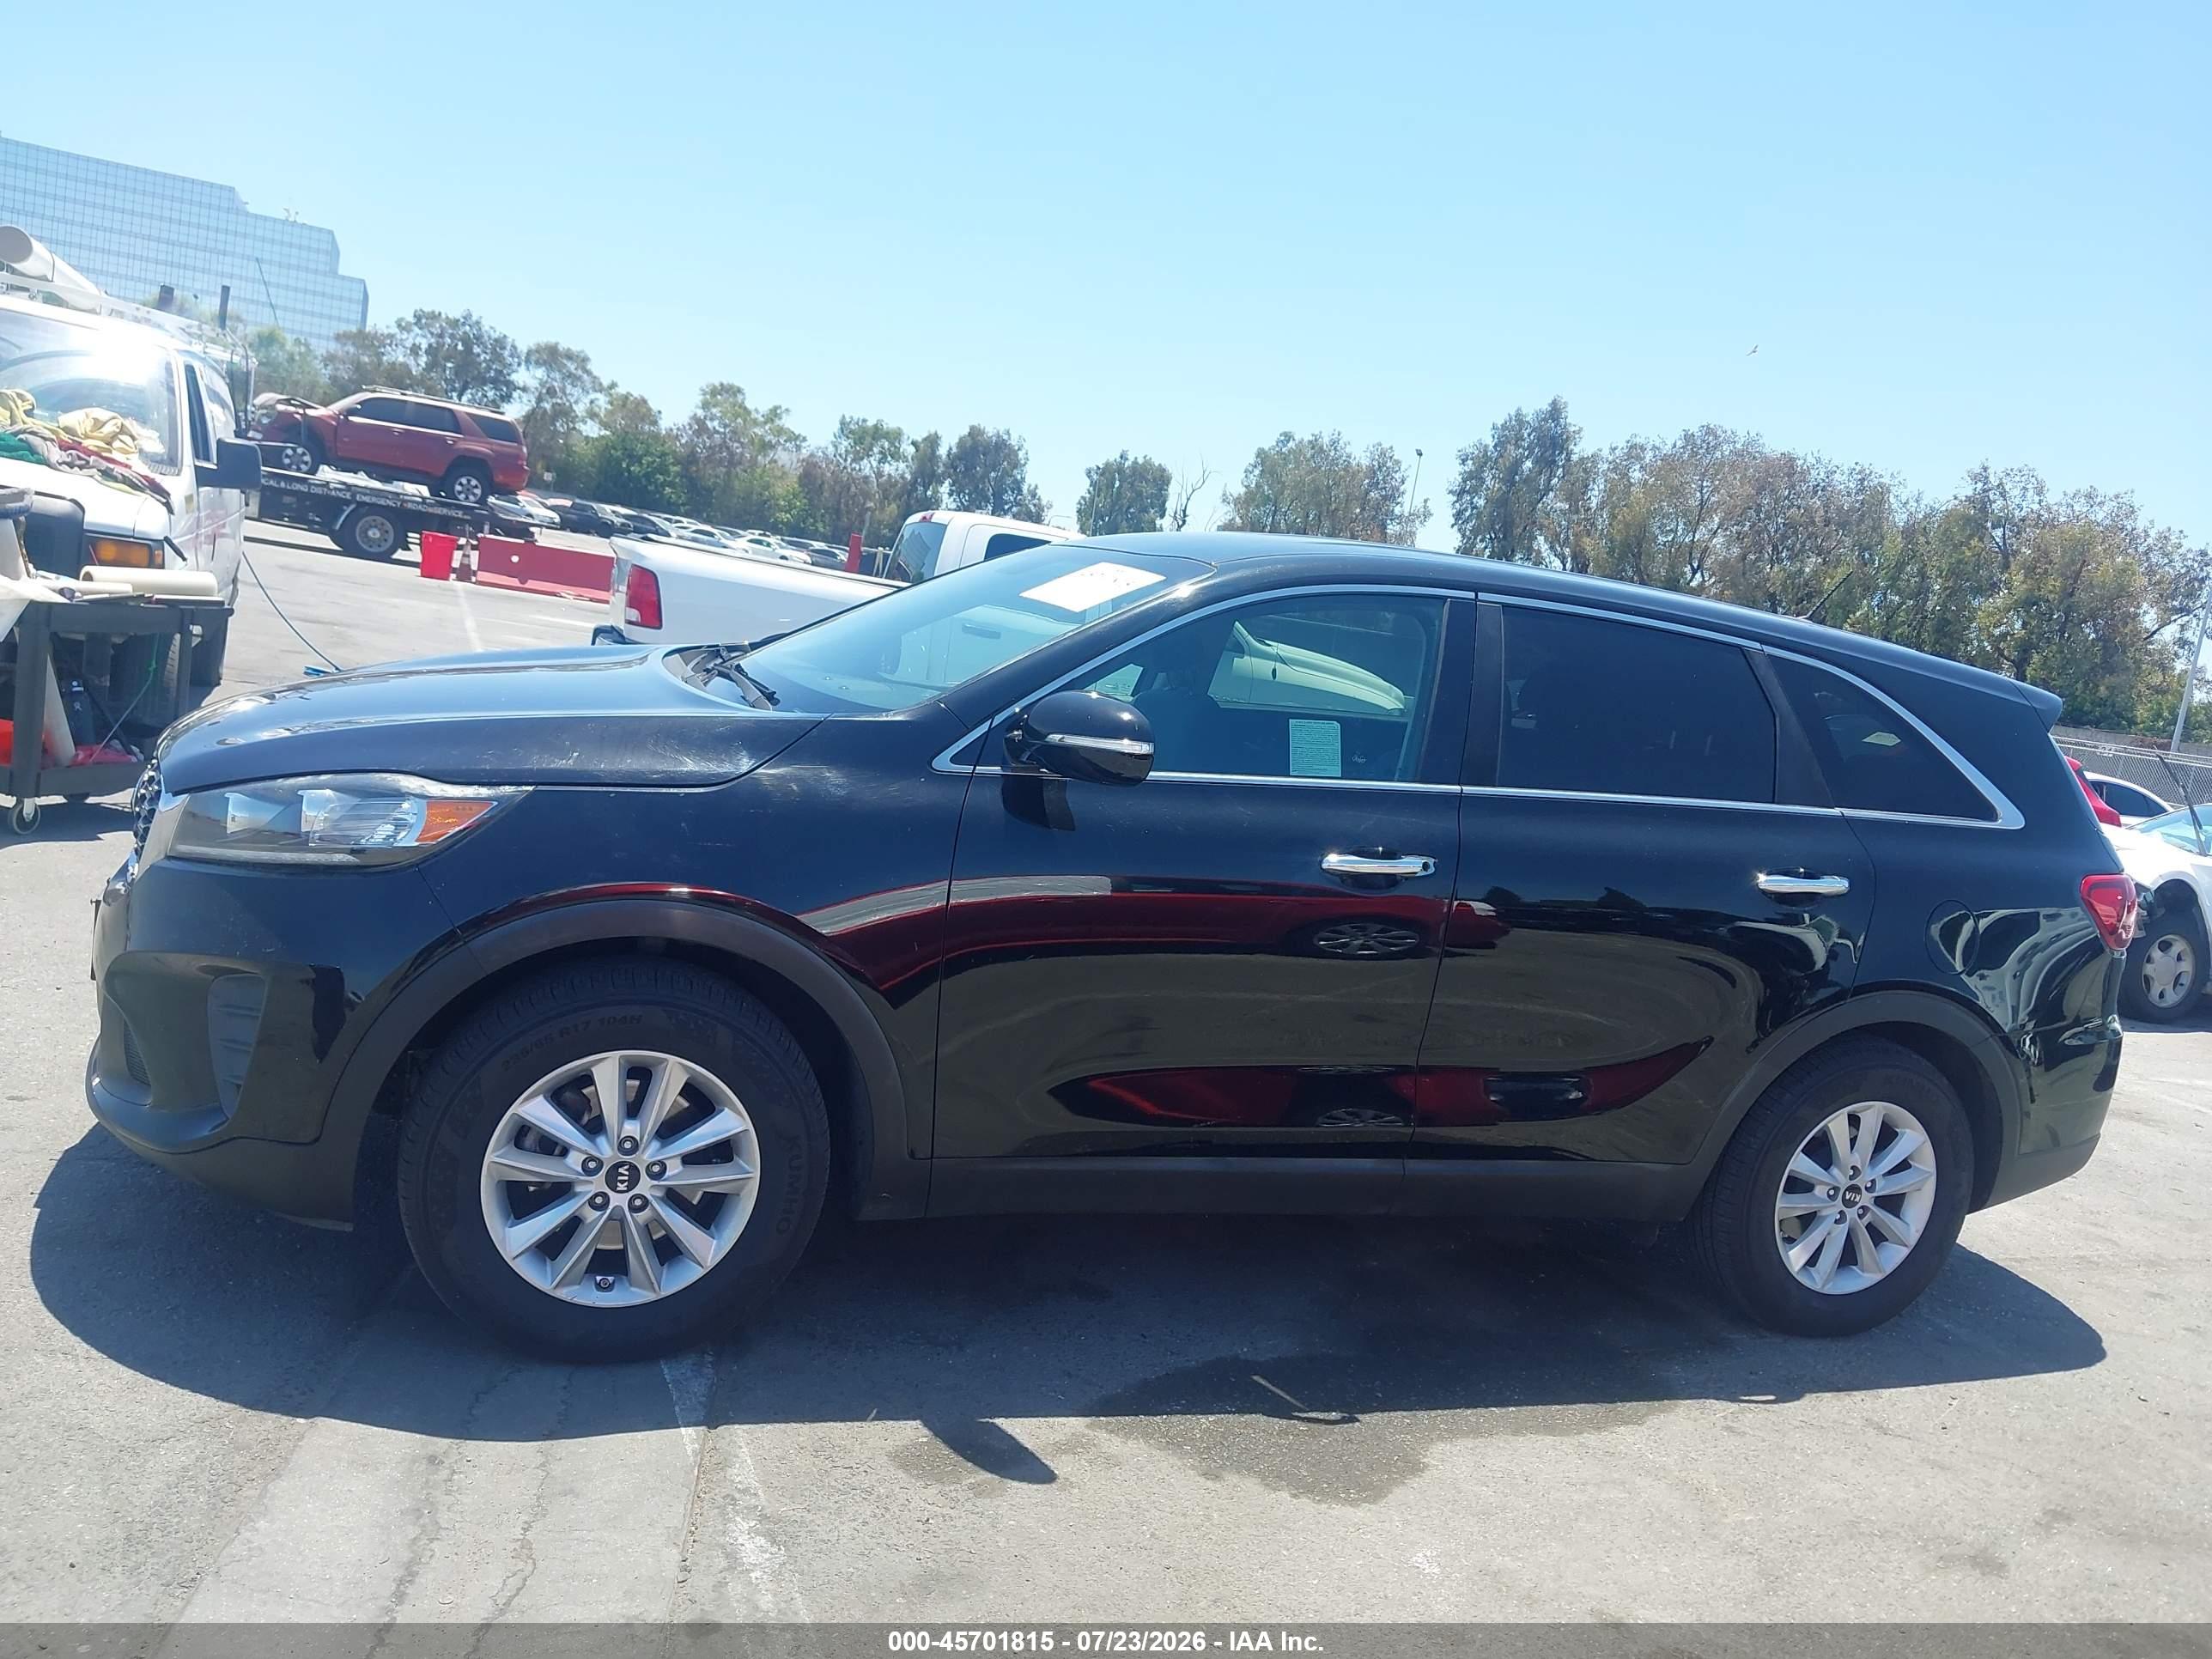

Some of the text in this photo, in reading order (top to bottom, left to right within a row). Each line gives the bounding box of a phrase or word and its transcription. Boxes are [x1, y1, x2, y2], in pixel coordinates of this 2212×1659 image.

[261, 478, 279, 489] CAL
[287, 482, 309, 493] LONG
[356, 494, 402, 508] EMERGENCY
[558, 1019, 592, 1038] R17
[597, 1013, 644, 1028] 104H
[616, 1164, 630, 1191] KIA
[1845, 1191, 1861, 1202] KIA
